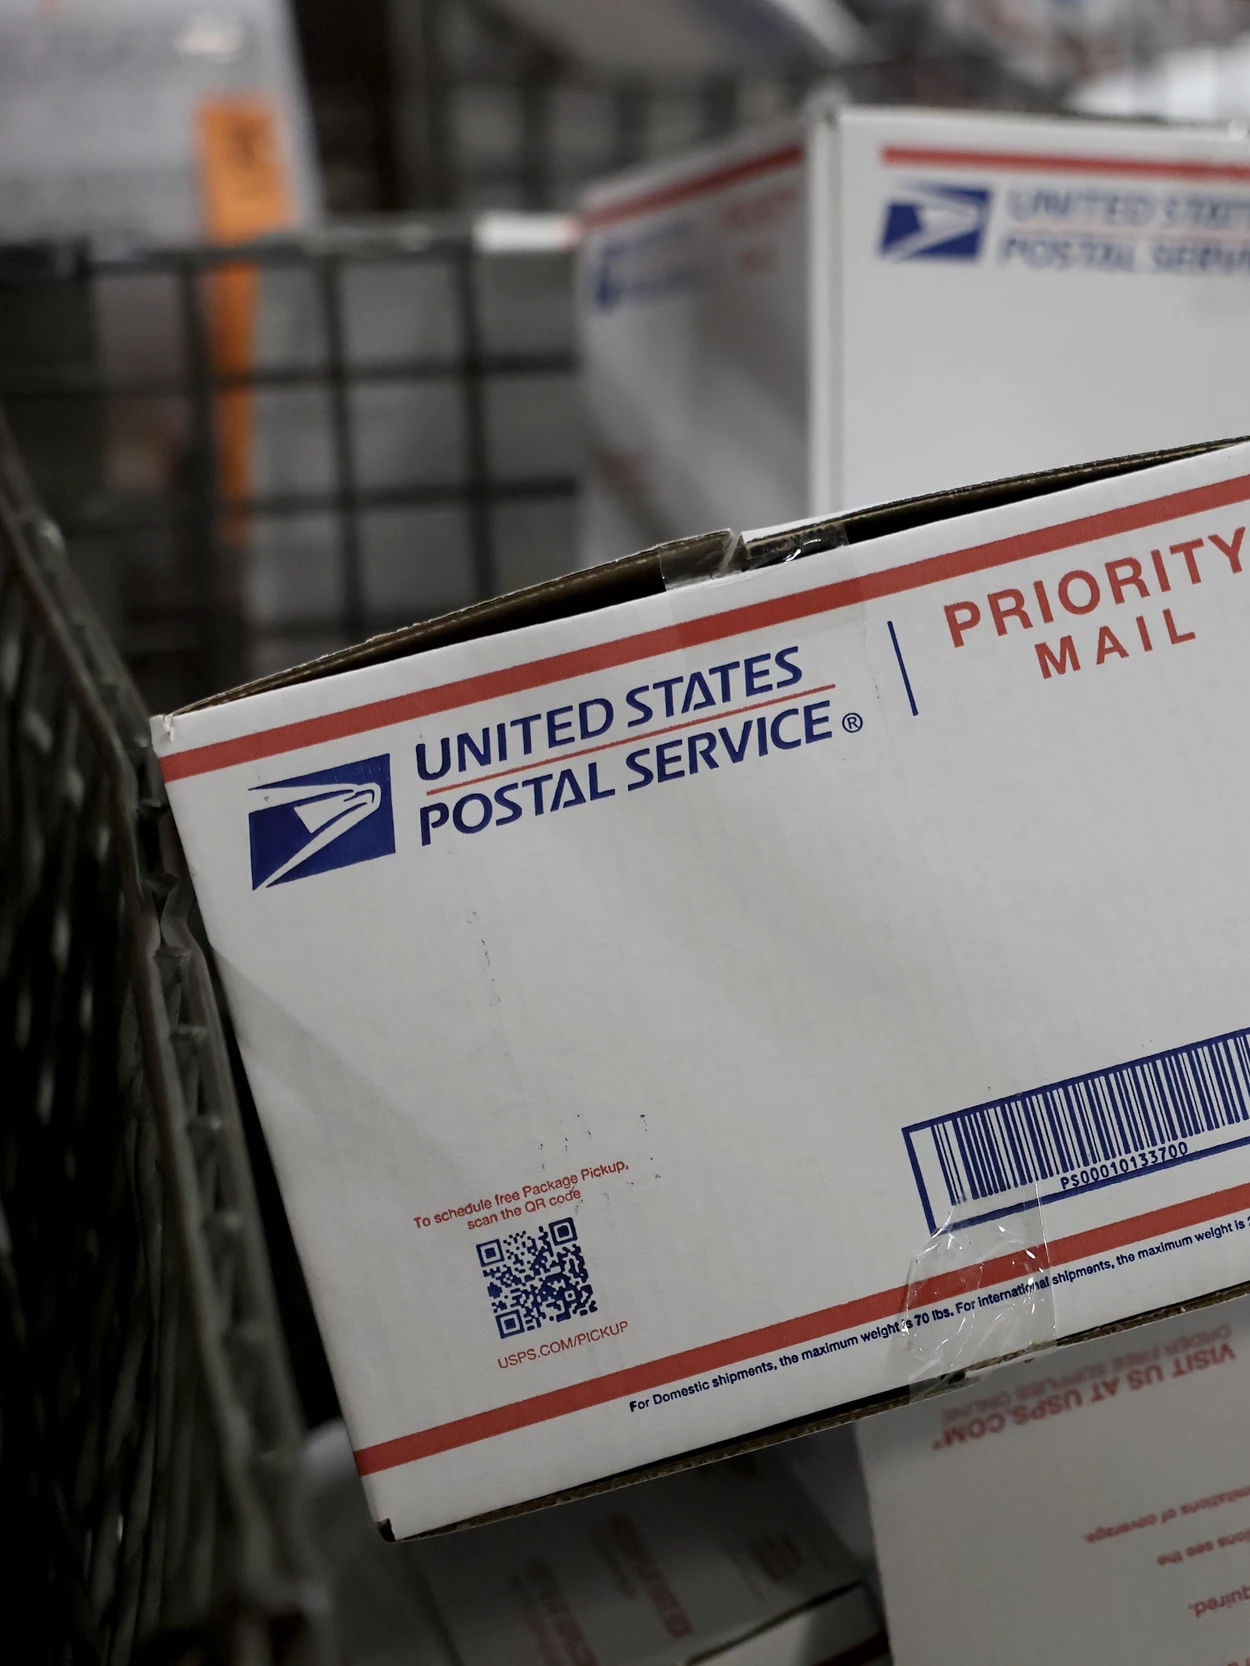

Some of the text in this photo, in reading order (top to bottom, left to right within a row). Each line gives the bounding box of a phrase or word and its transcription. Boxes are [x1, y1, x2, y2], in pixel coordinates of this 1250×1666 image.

[1034, 608, 1196, 680] MAIL
[415, 645, 803, 781] UNITED STATES
[418, 762, 616, 846] POSTAL
[1060, 1142, 1188, 1190] PS00010133700
[413, 1215, 431, 1229] To
[434, 1199, 493, 1225] schedule
[495, 1190, 520, 1206] free
[522, 1174, 579, 1198] Package
[467, 1188, 582, 1230] scan the QR code
[629, 1399, 649, 1412] For
[652, 1381, 709, 1404] Domestic
[712, 1362, 777, 1387] shipments,
[778, 1354, 798, 1366] the
[801, 1336, 858, 1359] maximum
[860, 1321, 900, 1343] weight
[913, 1312, 929, 1326] 70
[931, 1308, 954, 1320] lbs.
[955, 1300, 975, 1313] For
[977, 1275, 1050, 1306] international
[1052, 1260, 1114, 1284] shipments,
[1115, 1253, 1135, 1265] the
[1137, 1236, 1192, 1258] maximum
[1194, 1222, 1232, 1241] weight
[1233, 1219, 1245, 1230] is
[497, 1320, 629, 1369] USPS.COM/PICKUP
[1172, 1342, 1235, 1377] VISIT
[1090, 1373, 1120, 1402] AT
[1125, 1362, 1164, 1390] US
